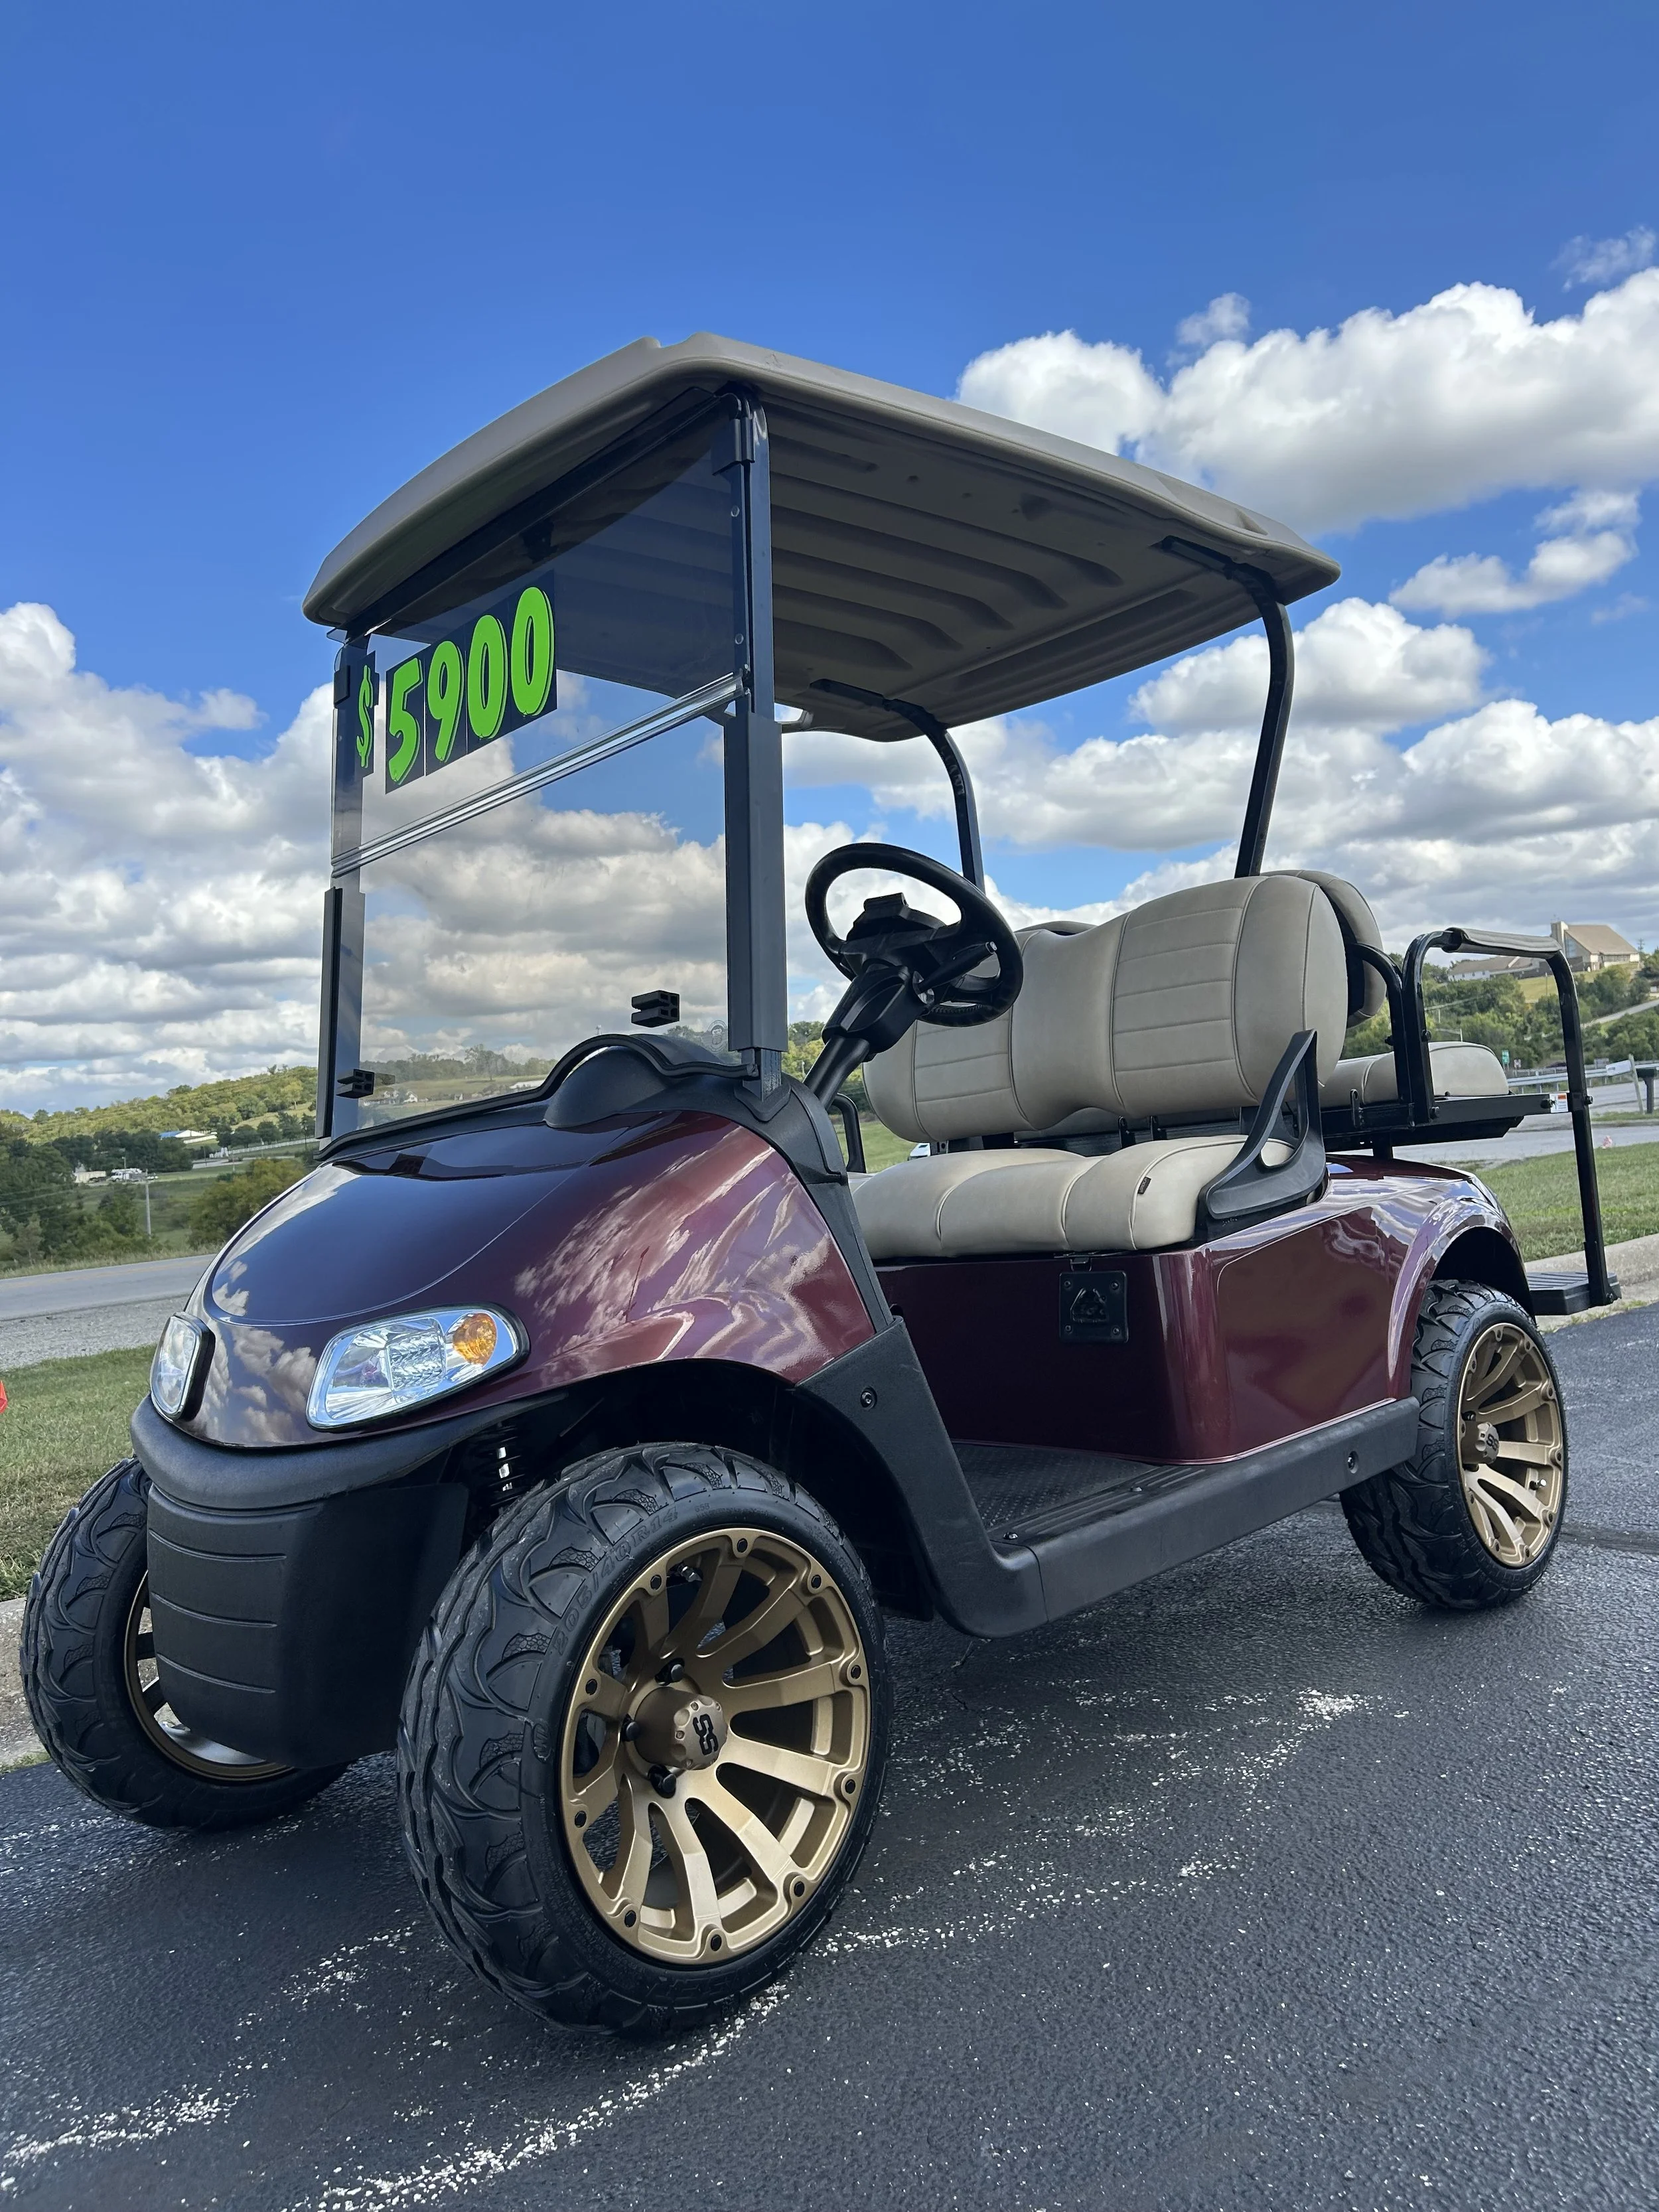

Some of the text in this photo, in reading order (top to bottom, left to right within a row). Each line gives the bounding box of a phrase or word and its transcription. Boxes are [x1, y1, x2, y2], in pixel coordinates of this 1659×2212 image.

[356, 586, 555, 785] $5900
[553, 1505, 680, 1657] 205/40R14
[692, 1714, 719, 1756] SS
